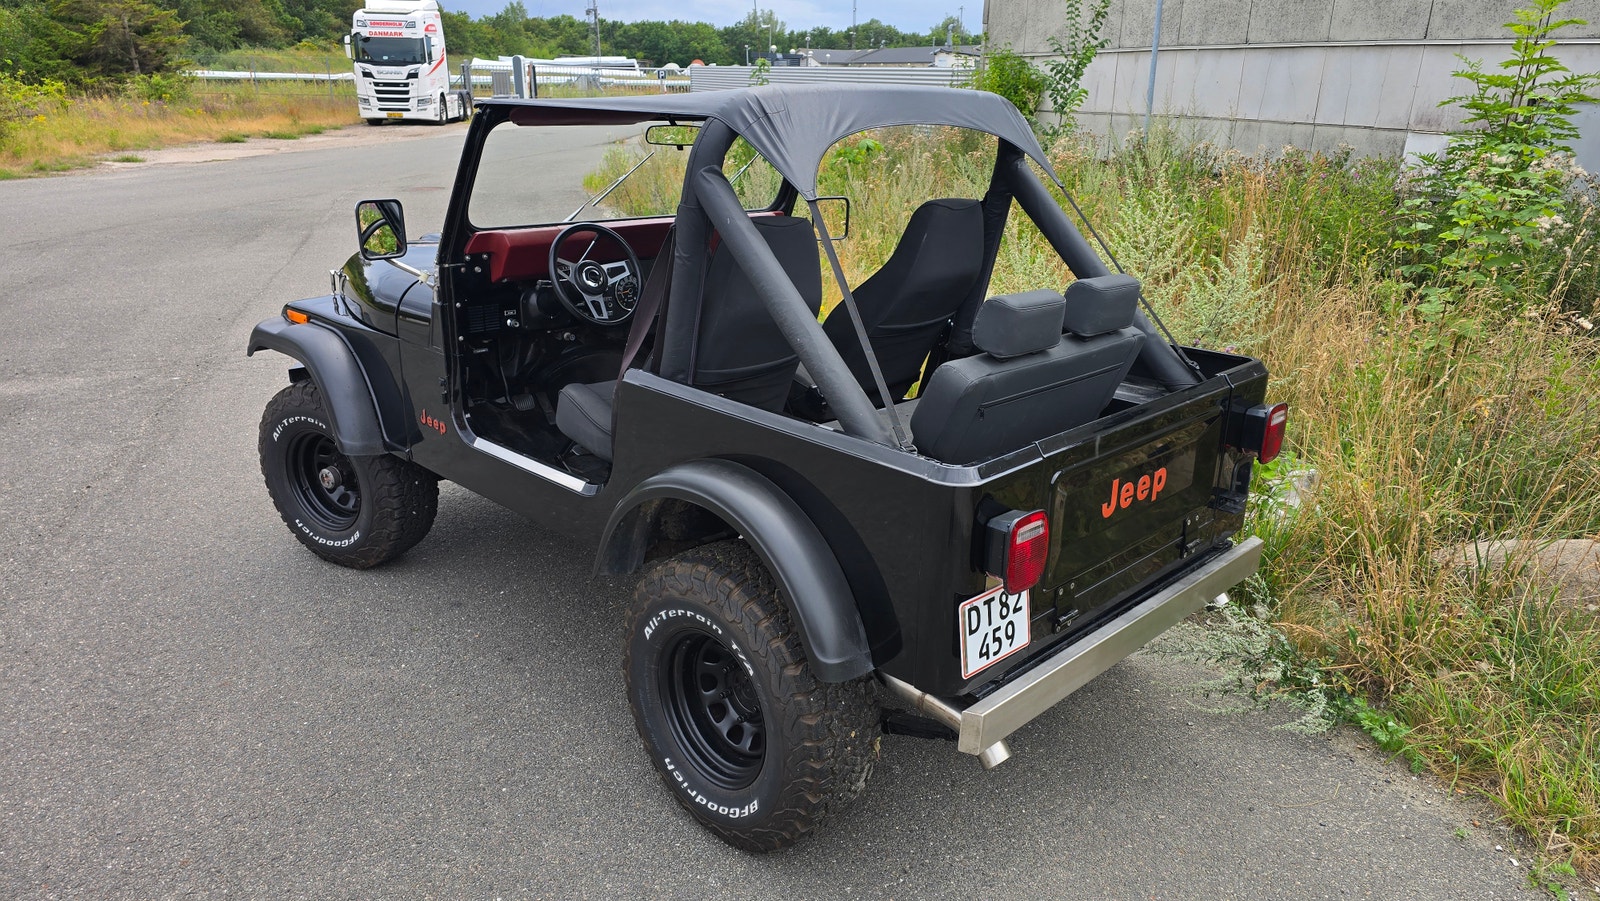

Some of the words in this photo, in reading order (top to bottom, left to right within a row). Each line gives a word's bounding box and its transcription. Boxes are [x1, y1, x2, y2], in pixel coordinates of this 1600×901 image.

[272, 415, 327, 442] All-Terrain
[420, 408, 447, 435] Jeep
[1101, 467, 1167, 519] Jeep
[295, 518, 361, 548] BFGoodrich
[643, 608, 723, 640] All-Terrain
[731, 640, 754, 677] T/A
[978, 620, 1016, 660] 459
[664, 757, 760, 819] BFGoodrich
